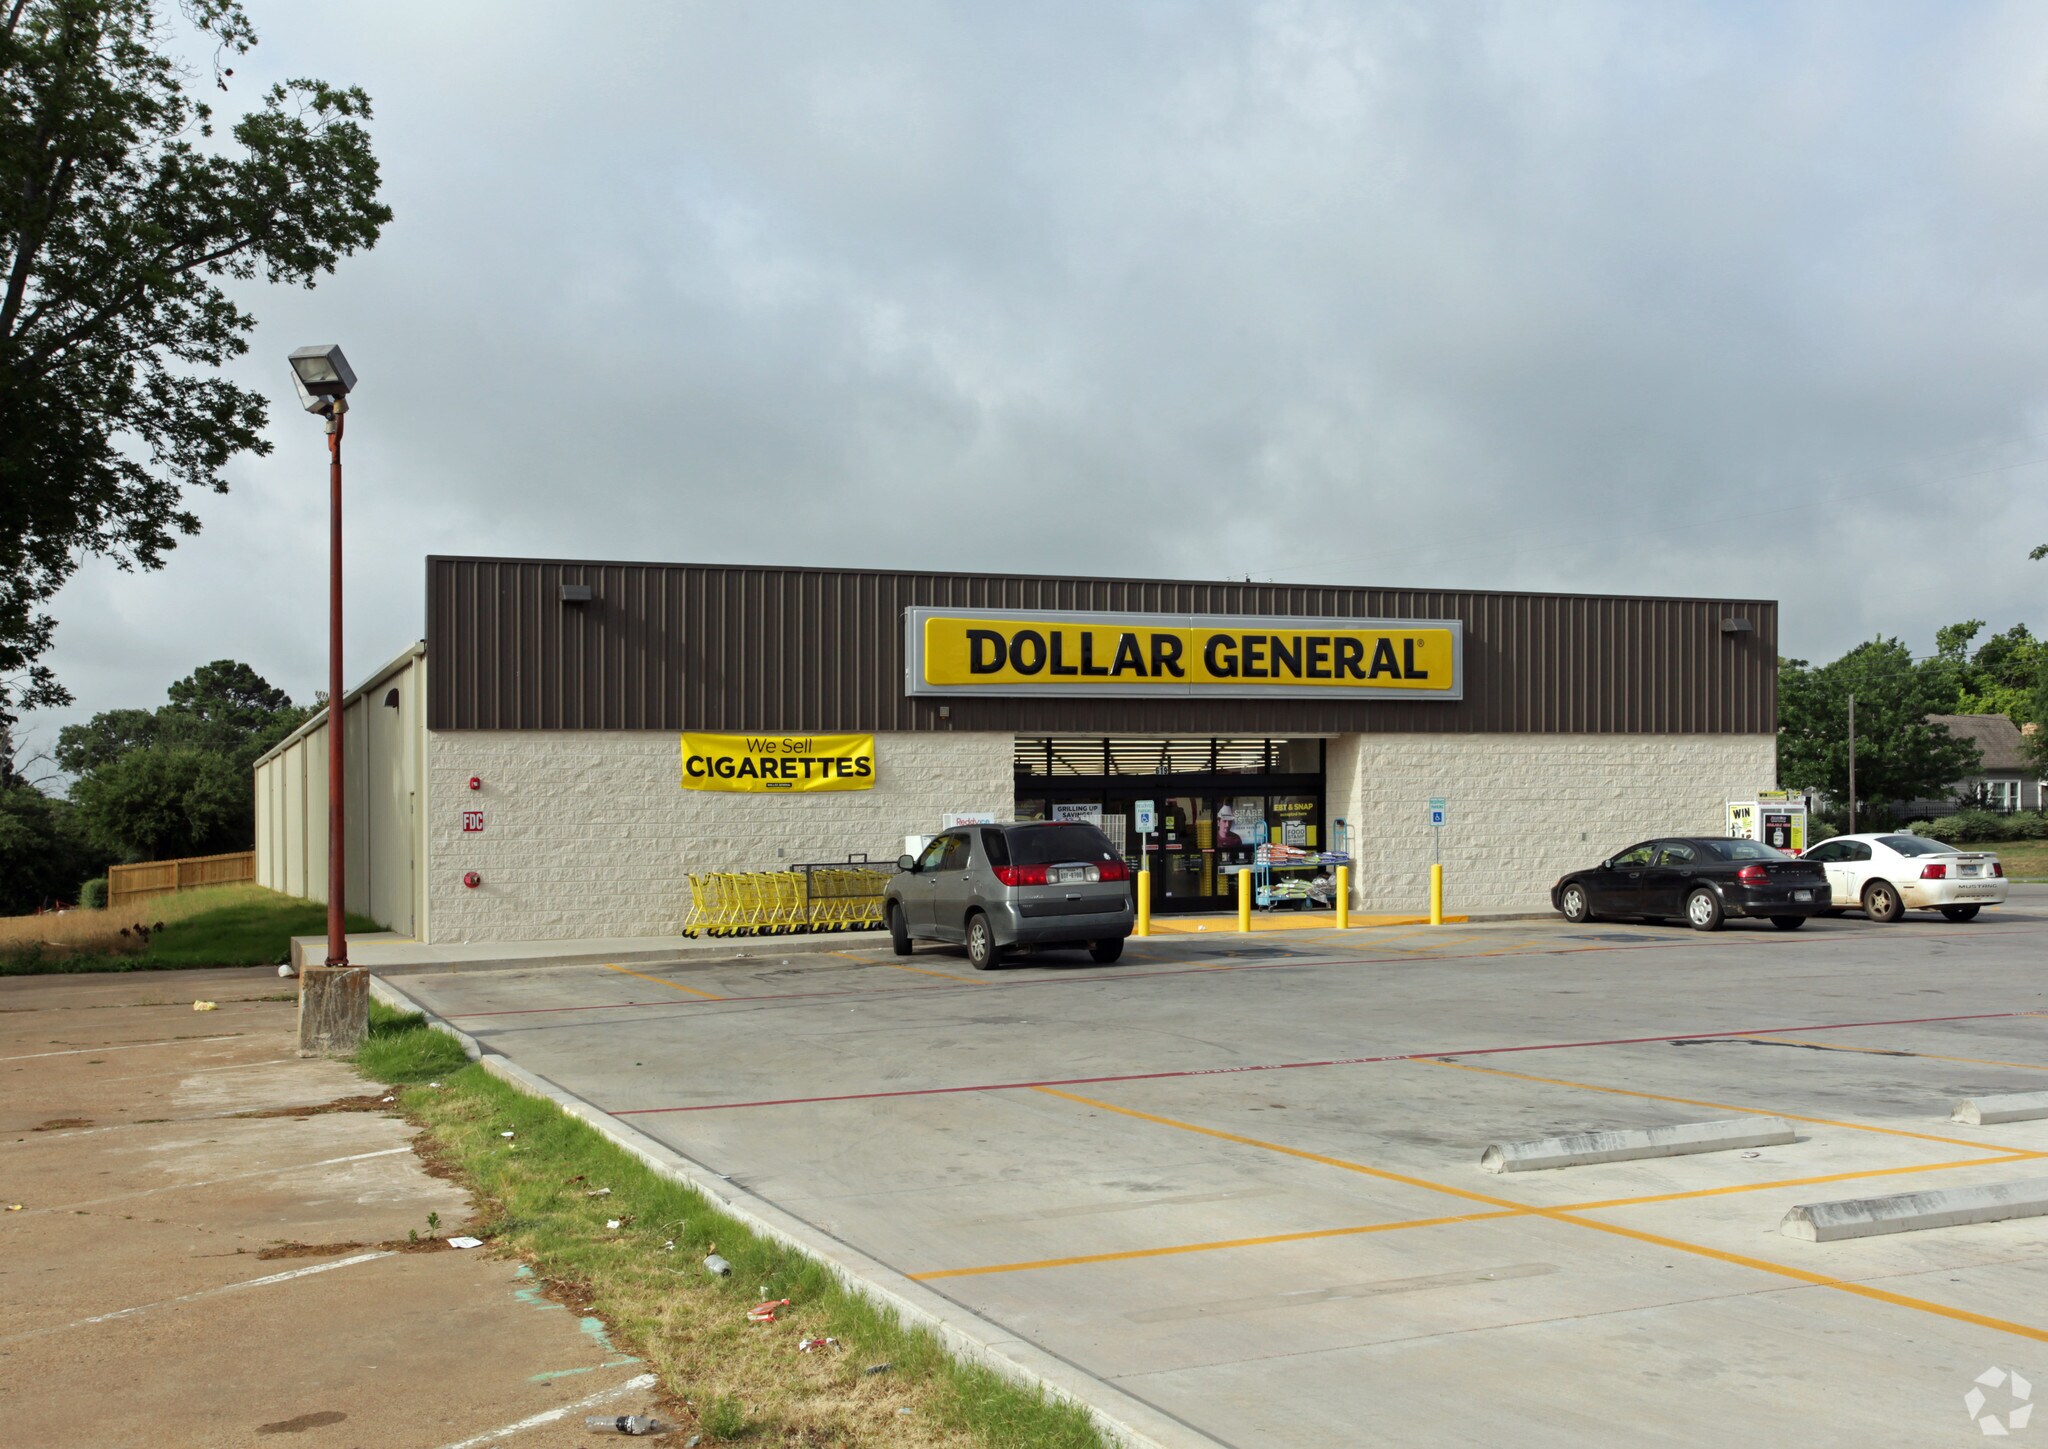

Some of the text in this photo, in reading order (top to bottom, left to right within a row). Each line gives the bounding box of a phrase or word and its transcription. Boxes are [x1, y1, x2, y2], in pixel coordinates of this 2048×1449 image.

[966, 630, 1428, 680] DOLLAR GENERAL
[746, 738, 812, 754] We Sell
[685, 755, 872, 779] CIGARETTES
[1156, 766, 1168, 775] 619
[1294, 803, 1313, 811] SNAP
[1733, 807, 1751, 819] WIN
[464, 813, 482, 830] FDC
